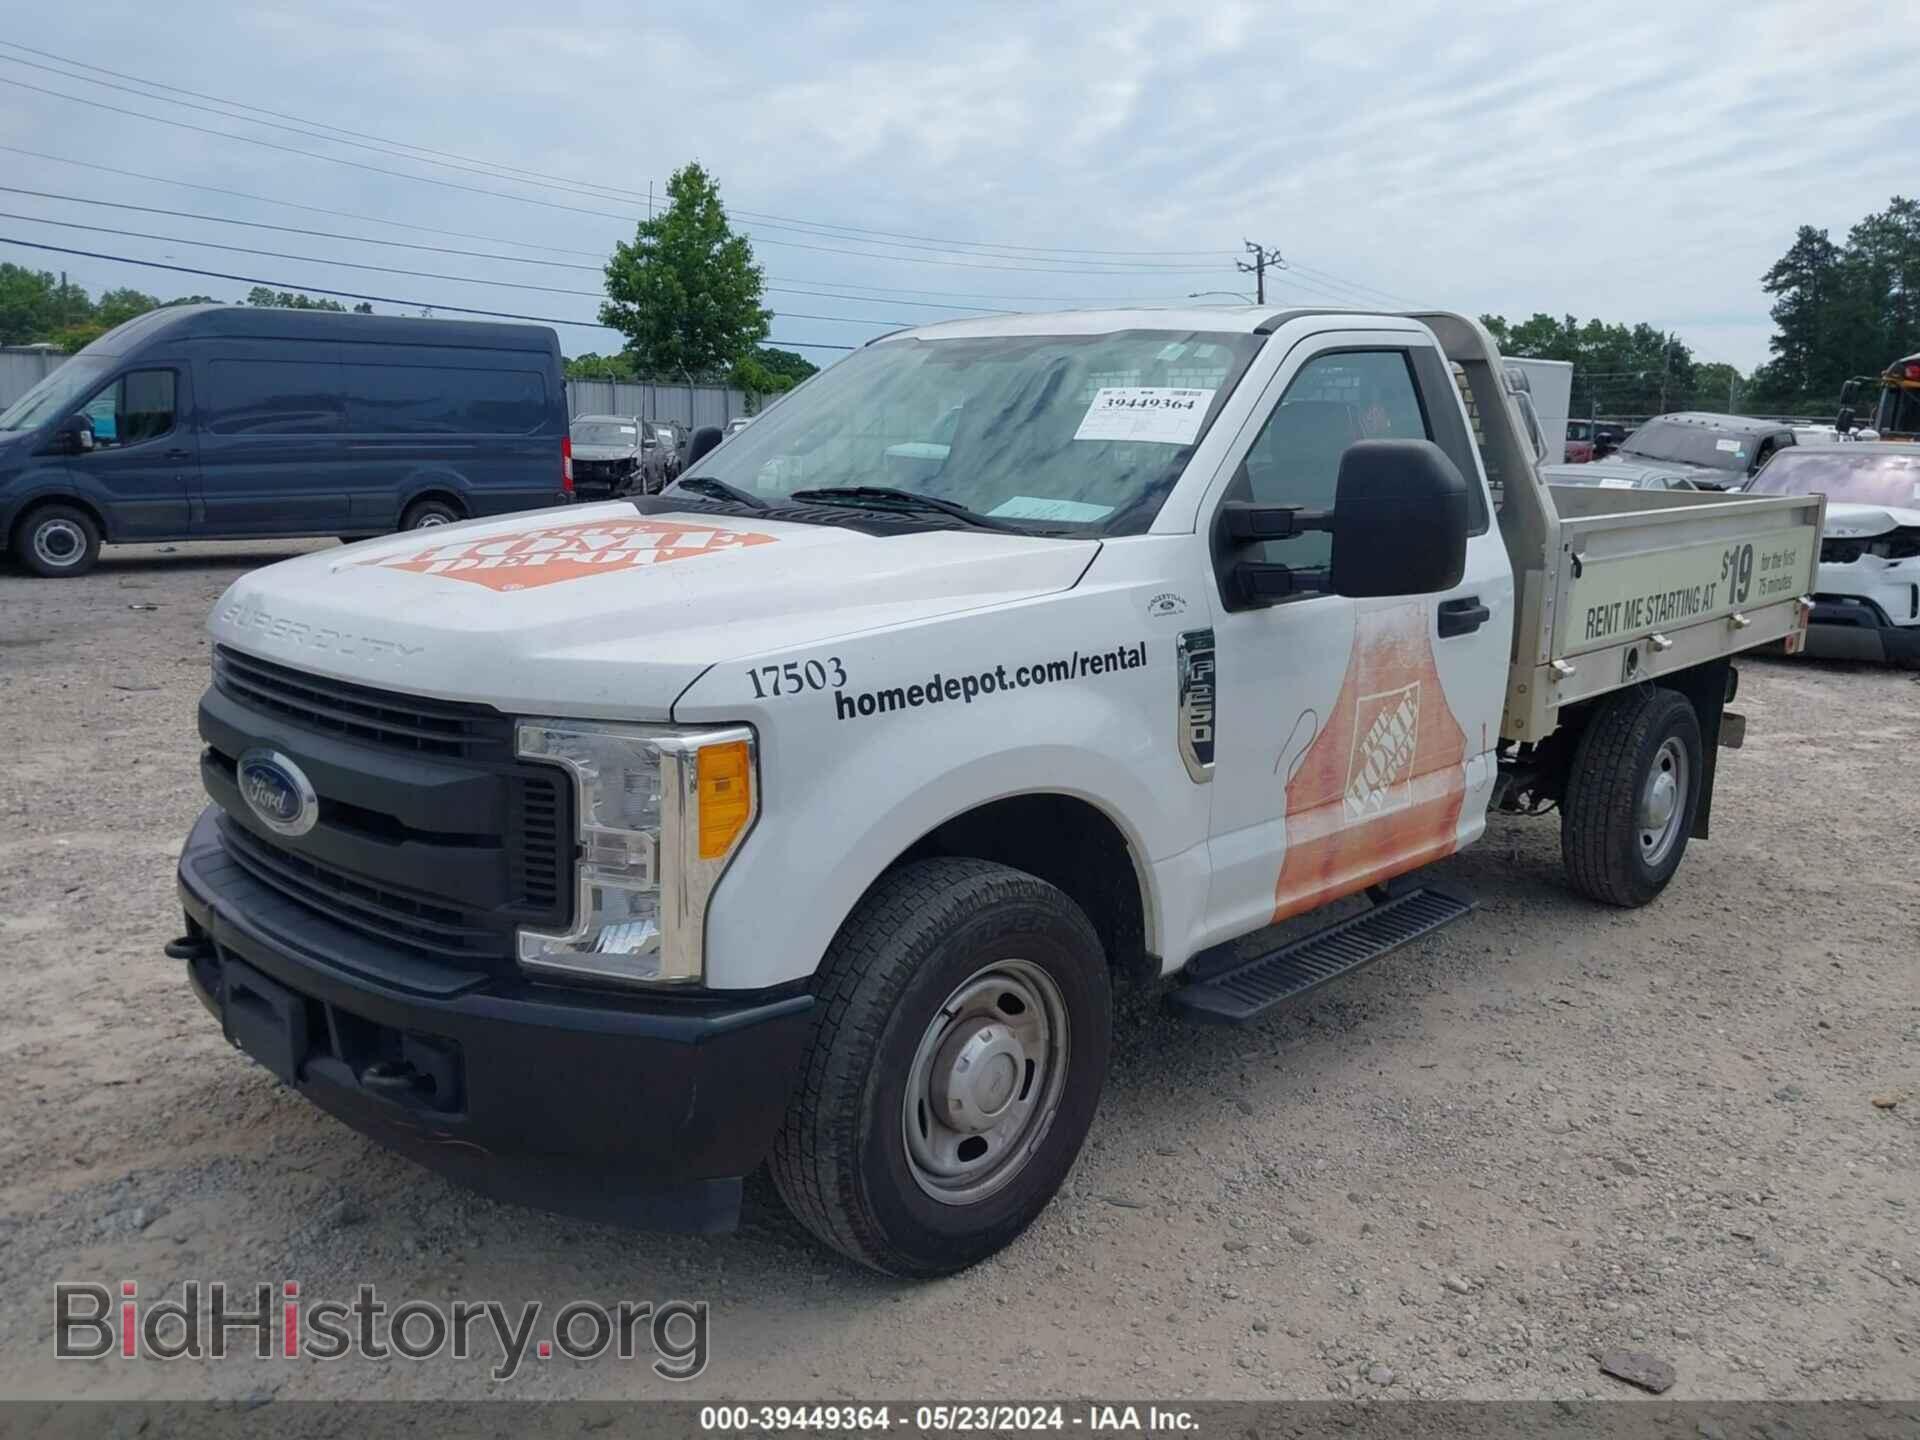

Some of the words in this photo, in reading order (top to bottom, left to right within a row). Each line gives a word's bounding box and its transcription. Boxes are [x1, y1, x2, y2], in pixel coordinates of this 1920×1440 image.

[1102, 398, 1195, 411] 39449364
[376, 532, 752, 567] HOME
[424, 549, 675, 575] DEPOT
[1585, 602, 1622, 640] RENT
[1623, 598, 1643, 631] ME
[1645, 585, 1701, 626] STARTING
[1701, 583, 1717, 612] AT
[1721, 543, 1753, 605] $19
[1767, 574, 1793, 594] minutes
[220, 604, 311, 646] SUPER
[308, 627, 425, 668] DUTY
[746, 657, 848, 699] 17503
[834, 641, 1148, 720] homedepot.com/rental
[1346, 688, 1417, 816] HOME
[247, 769, 289, 814] Ford
